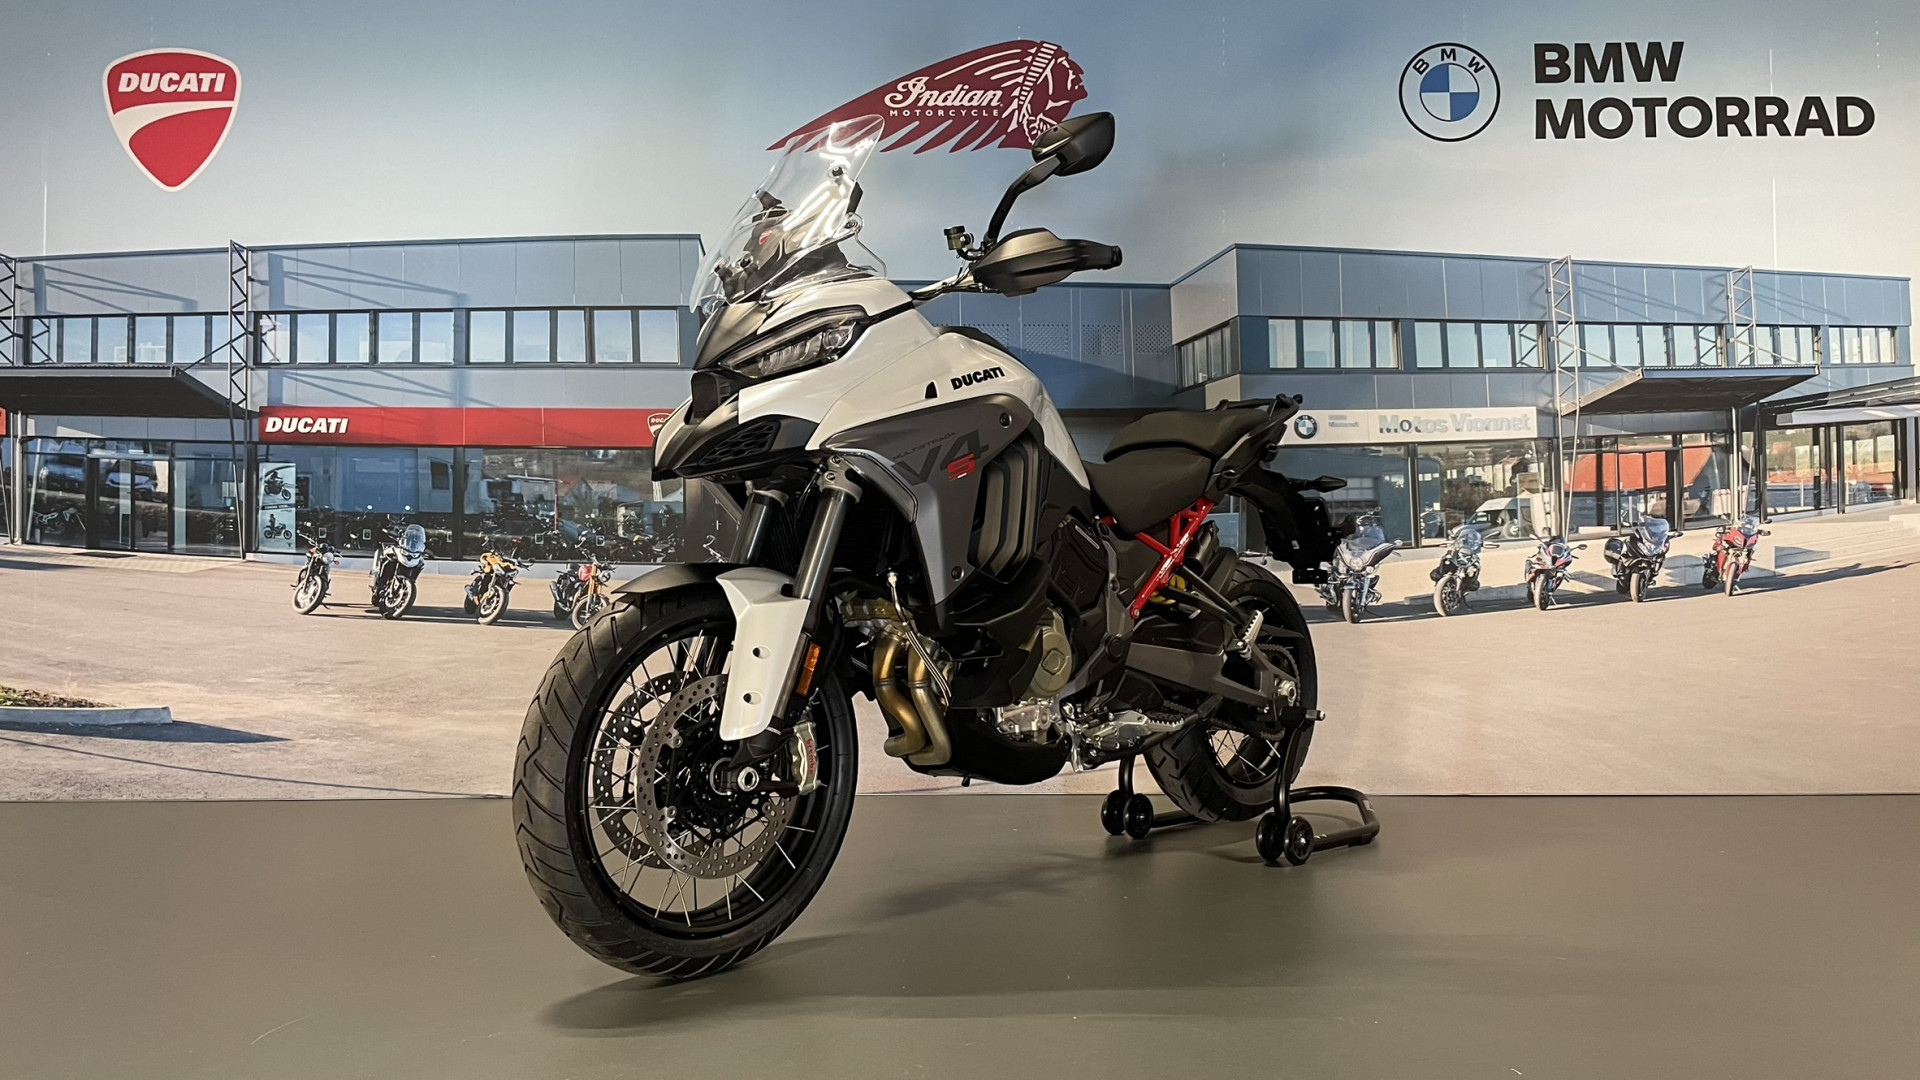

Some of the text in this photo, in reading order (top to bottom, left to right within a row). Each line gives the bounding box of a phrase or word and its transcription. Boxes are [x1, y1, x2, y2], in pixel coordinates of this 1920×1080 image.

[1412, 48, 1486, 75] BMW
[1534, 41, 1684, 83] BMW
[118, 72, 226, 92] DUCATI
[884, 76, 1001, 108] Indian
[889, 109, 999, 117] MOTORCYCLE
[1535, 96, 1875, 139] MOTORRAD
[950, 366, 1006, 391] DUCATI
[265, 417, 348, 433] DUCATI
[1378, 412, 1531, 434] Motos Vionnet
[806, 738, 816, 775] brembo
